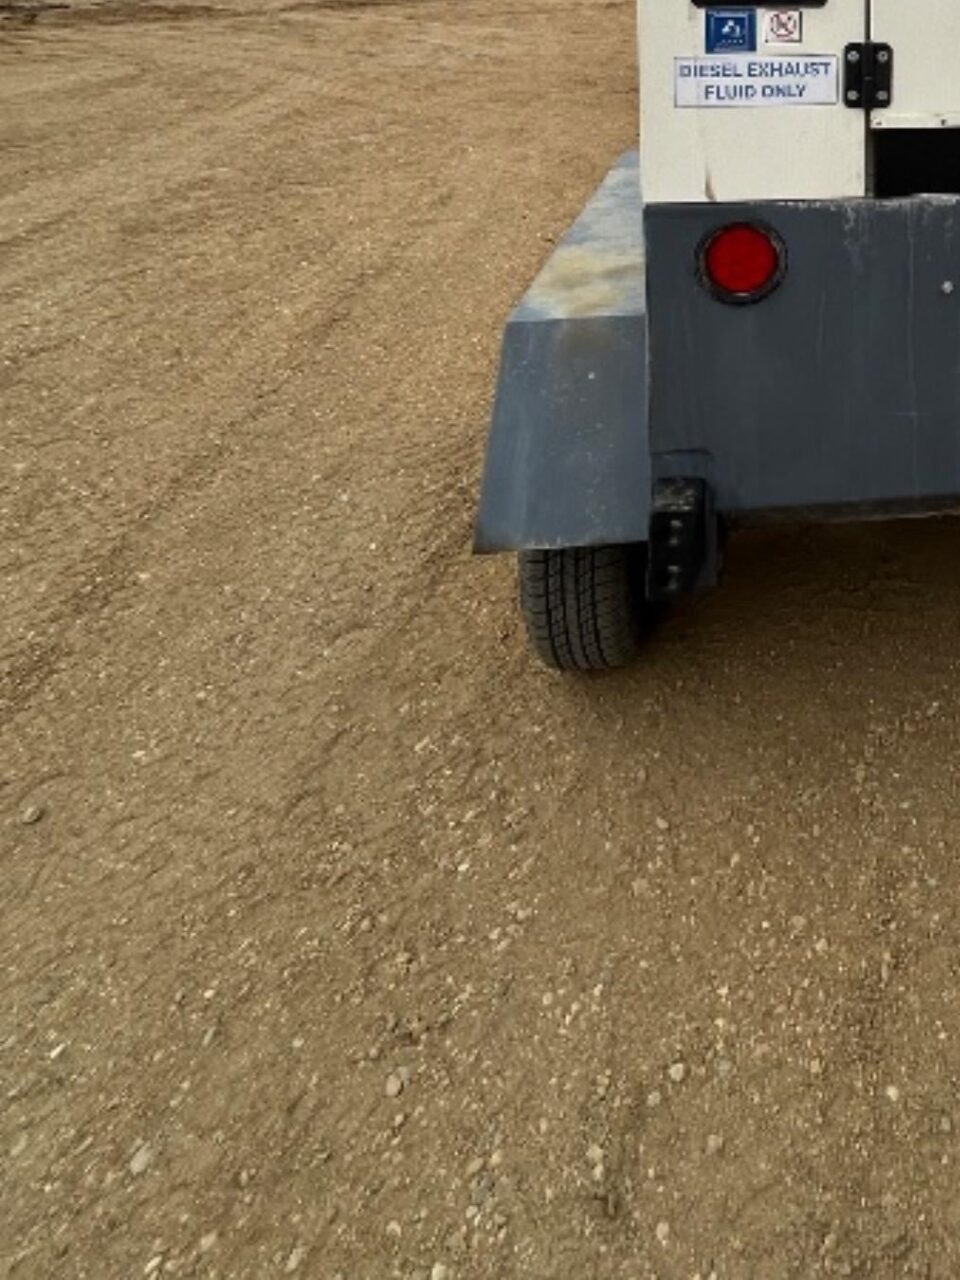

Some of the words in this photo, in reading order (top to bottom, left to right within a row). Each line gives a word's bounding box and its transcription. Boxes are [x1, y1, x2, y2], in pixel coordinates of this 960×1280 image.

[679, 62, 743, 78] DIESEL
[747, 61, 832, 78] EXHAUST
[704, 84, 757, 100] FLUID
[761, 83, 807, 99] ONLY
